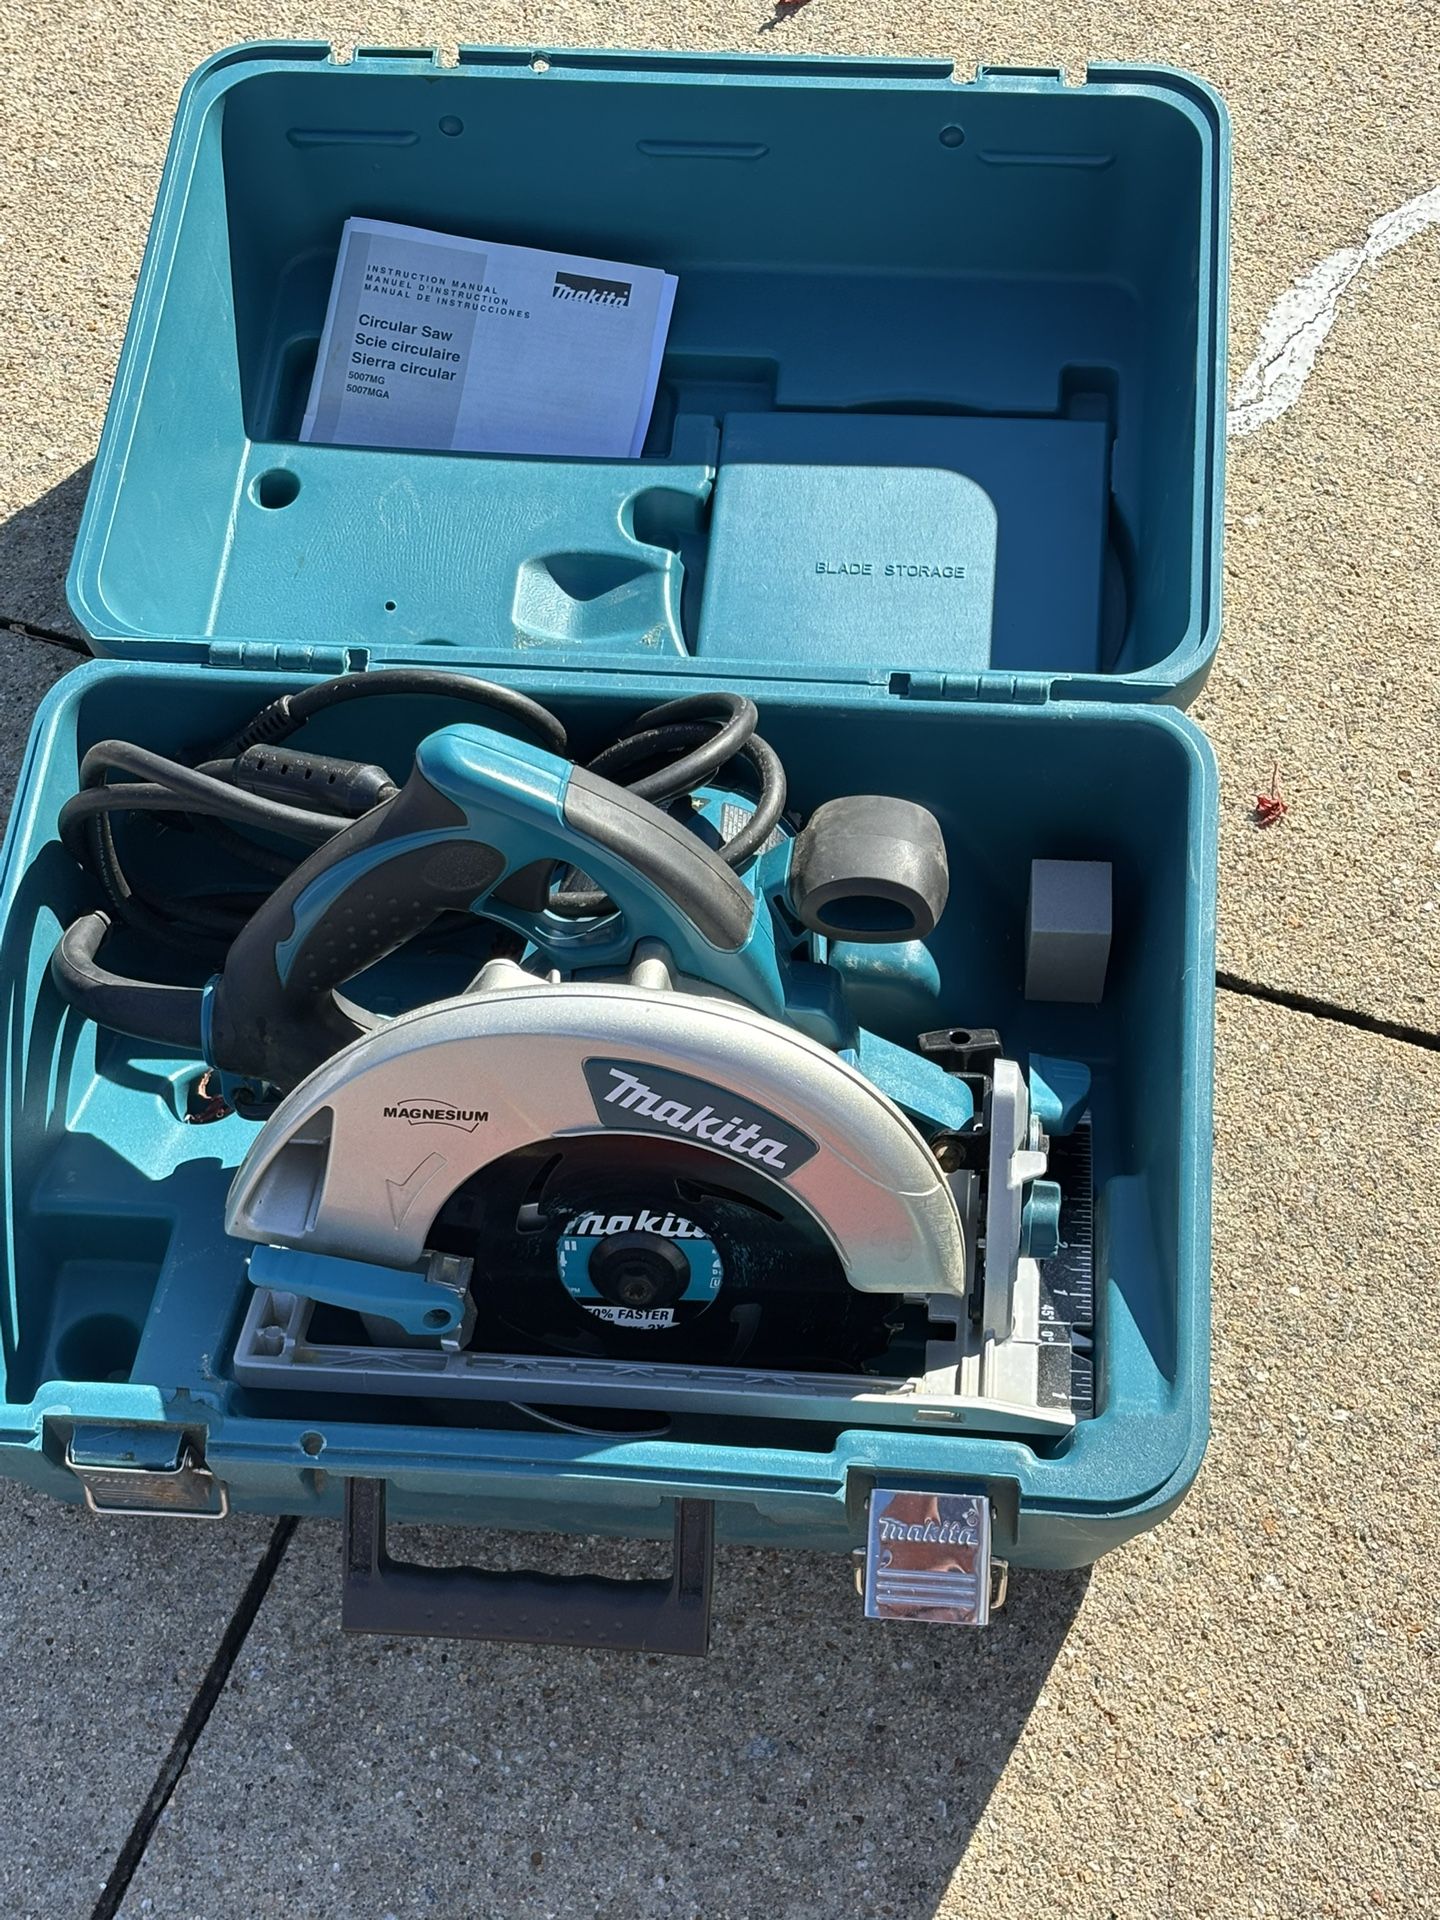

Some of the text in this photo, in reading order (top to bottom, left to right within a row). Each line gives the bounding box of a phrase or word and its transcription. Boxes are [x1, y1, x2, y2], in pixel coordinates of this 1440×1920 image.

[365, 274, 509, 305] MANUEL D'INSTRUCTION
[367, 264, 498, 294] INSTRUCTION MANUAL
[364, 284, 531, 319] MANUAL DE INSTRUCCIONES
[358, 314, 453, 342] Circular Saw
[355, 333, 461, 363] Scie circulaire
[347, 371, 385, 385] 5007MG
[351, 352, 457, 382] Sierra circular
[345, 384, 390, 400] 5007MGA
[815, 562, 965, 579] BLADE STORAGE
[383, 1106, 489, 1123] MAGNESIUM
[617, 1308, 670, 1321] FASTER
